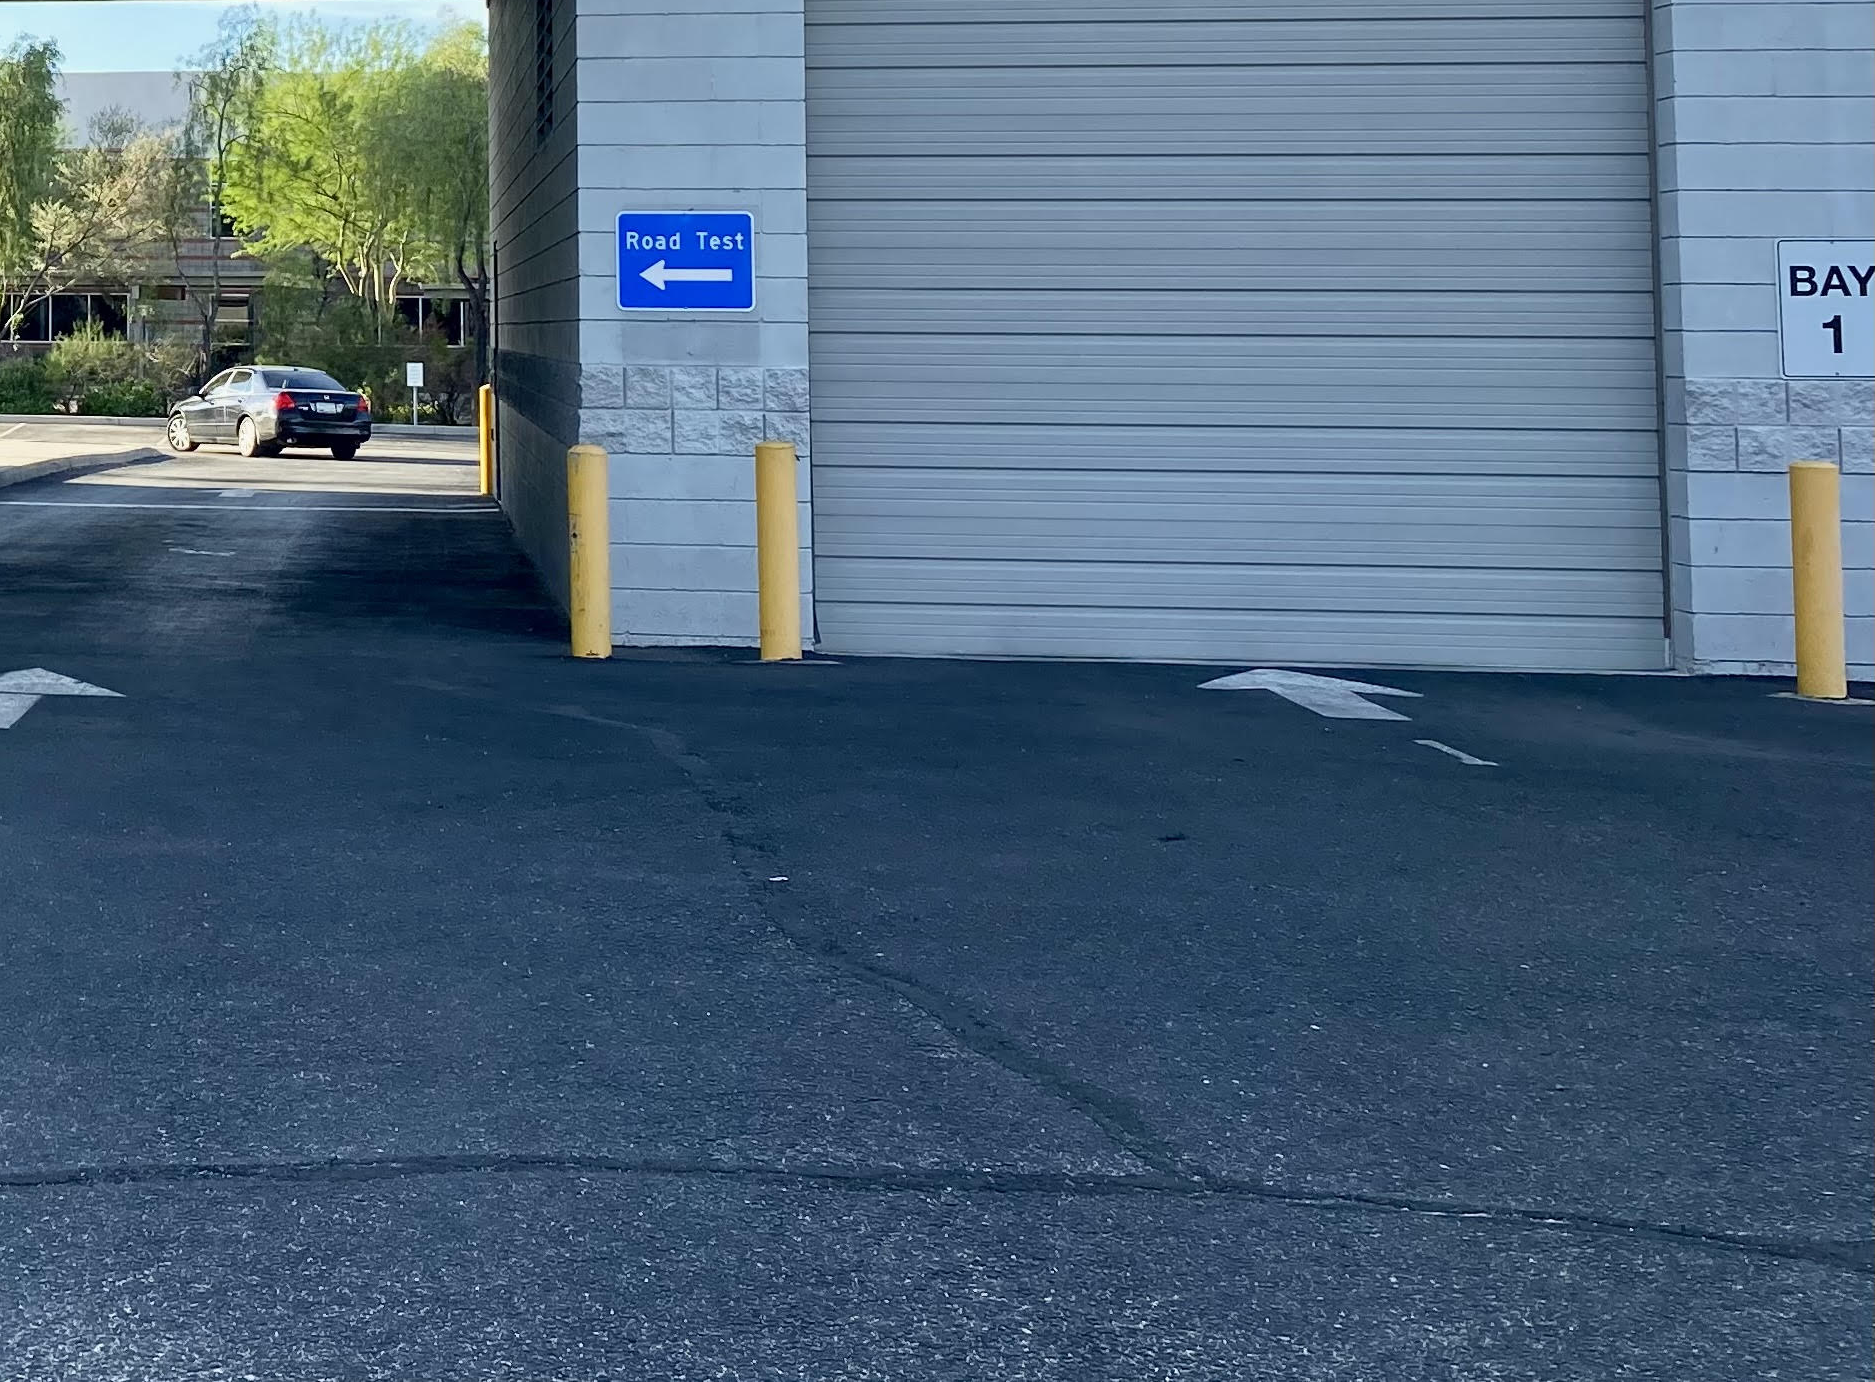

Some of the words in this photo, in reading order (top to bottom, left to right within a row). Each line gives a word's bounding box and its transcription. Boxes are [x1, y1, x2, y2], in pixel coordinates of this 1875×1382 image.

[626, 231, 681, 250] Road
[695, 231, 745, 250] Test
[1789, 265, 1875, 297] BAY
[1822, 315, 1843, 354] 1
